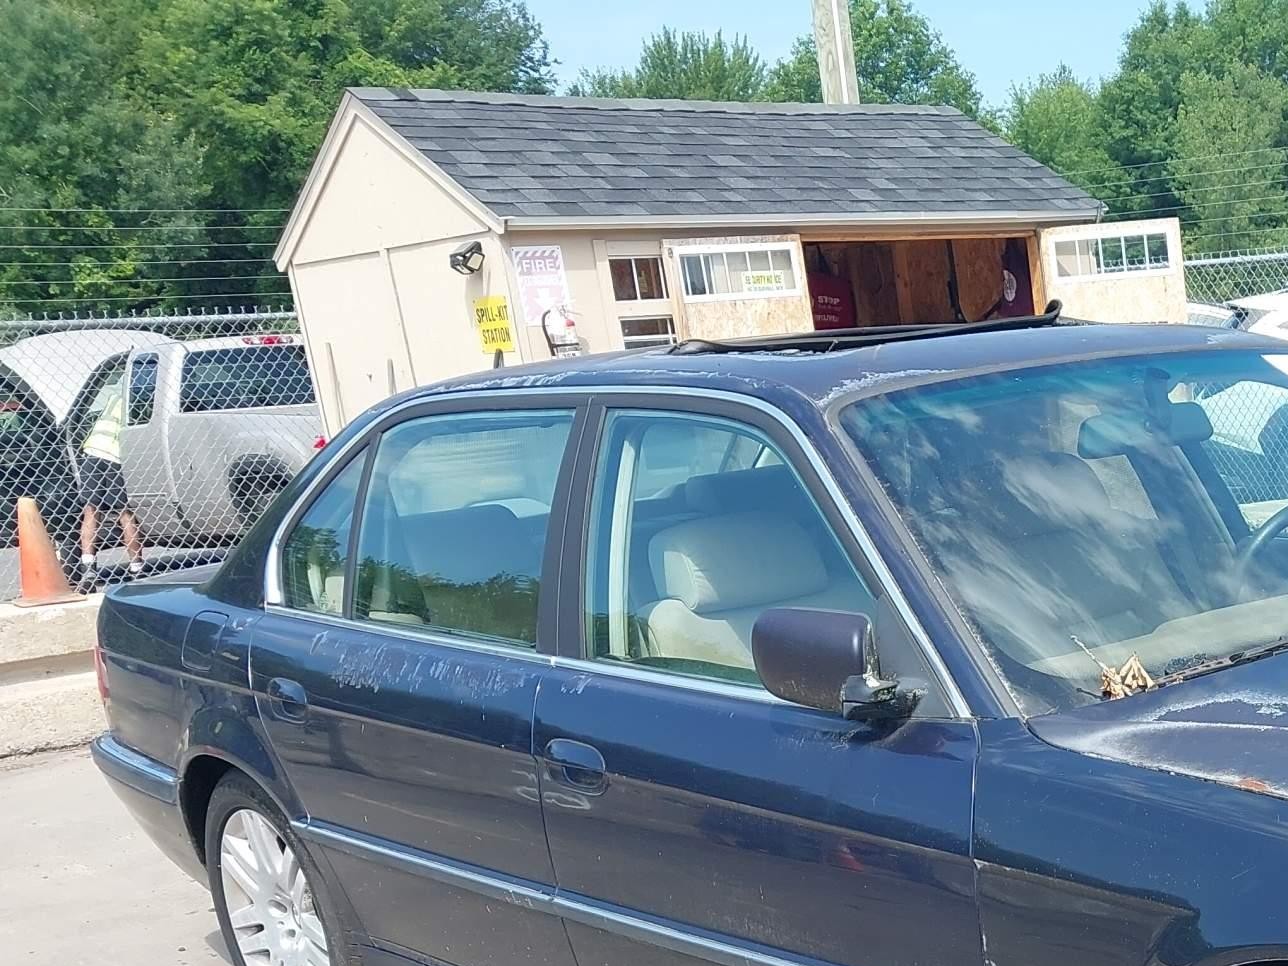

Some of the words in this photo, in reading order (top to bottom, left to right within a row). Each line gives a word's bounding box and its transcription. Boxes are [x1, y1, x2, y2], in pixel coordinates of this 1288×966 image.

[522, 259, 556, 272] FIRE
[476, 304, 509, 324] SPILL-KIT
[482, 327, 511, 344] STATION
